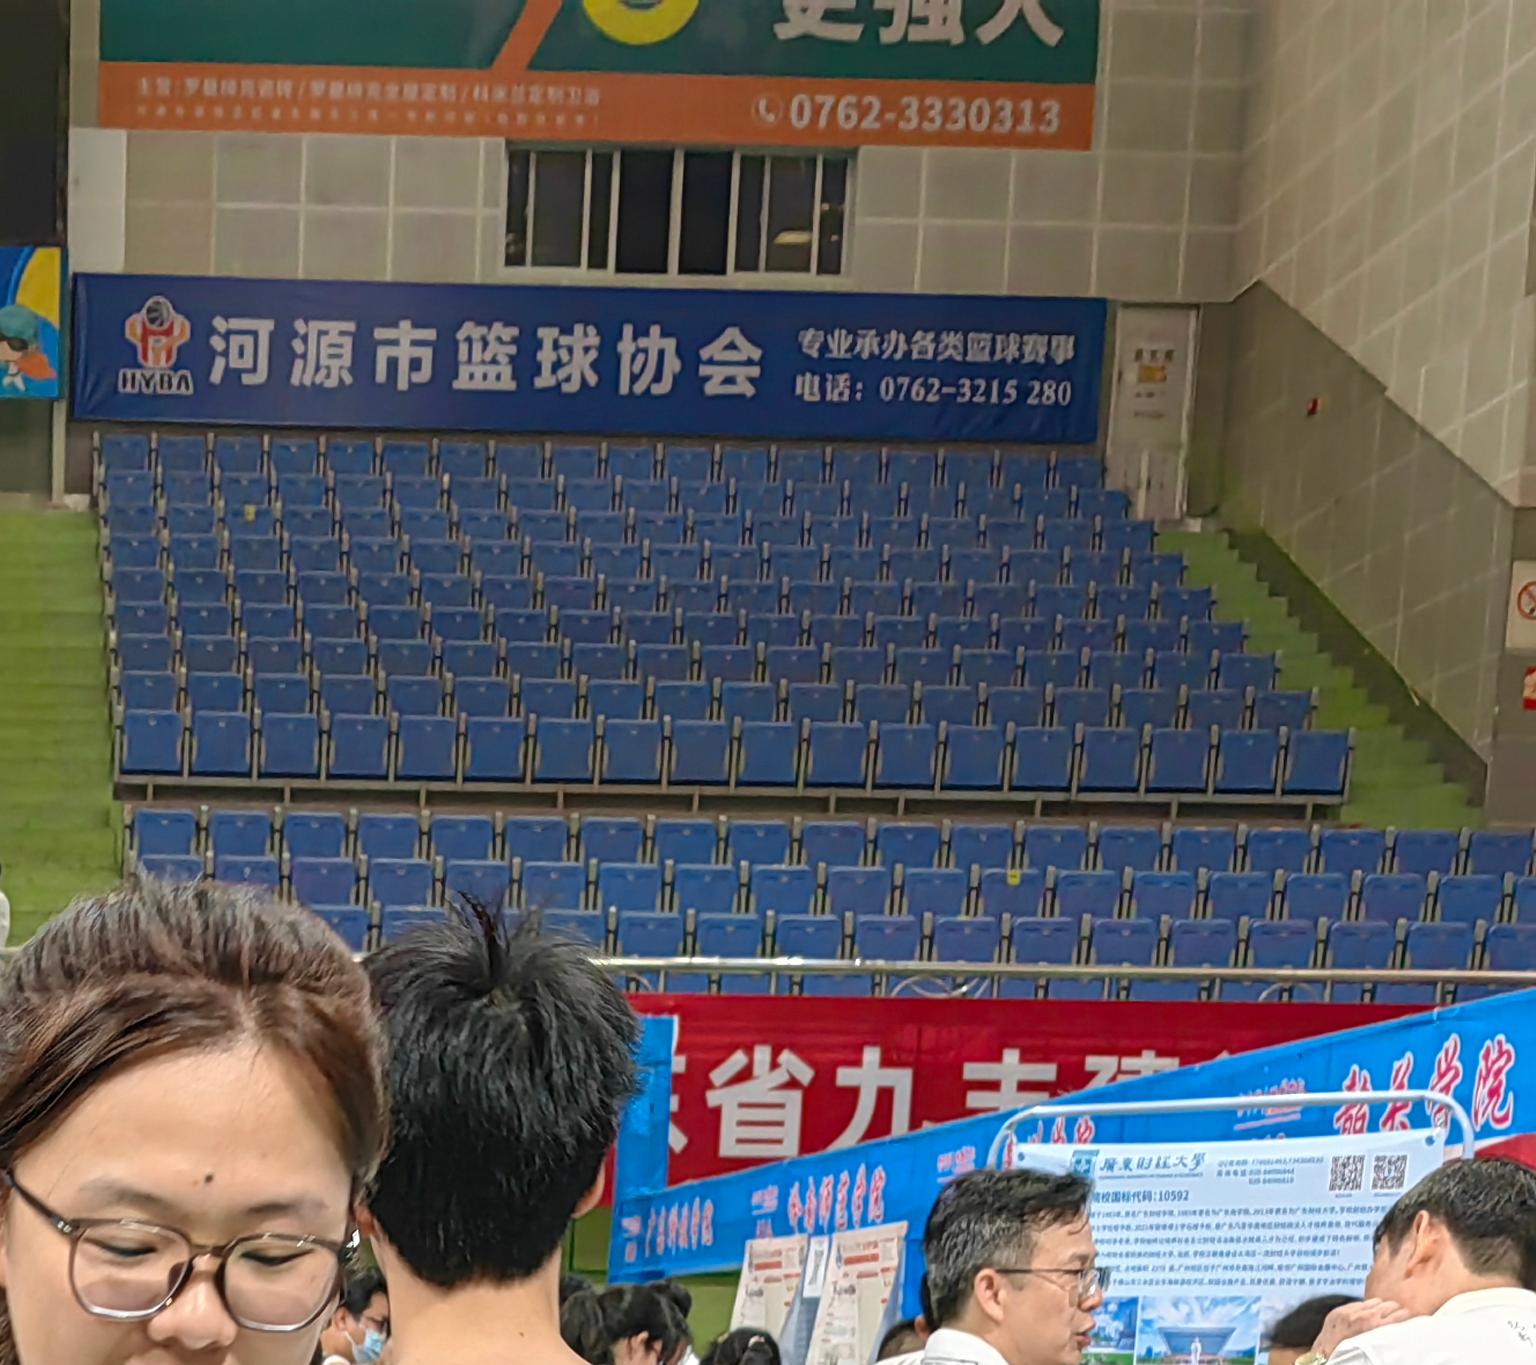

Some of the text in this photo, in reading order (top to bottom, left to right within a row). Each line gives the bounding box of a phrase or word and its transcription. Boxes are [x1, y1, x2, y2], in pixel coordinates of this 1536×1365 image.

[789, 94, 1061, 133] 0762-3330313
[209, 314, 764, 398] 河源市篮球协会
[798, 327, 1076, 366] 专业承办各类篮球赛事
